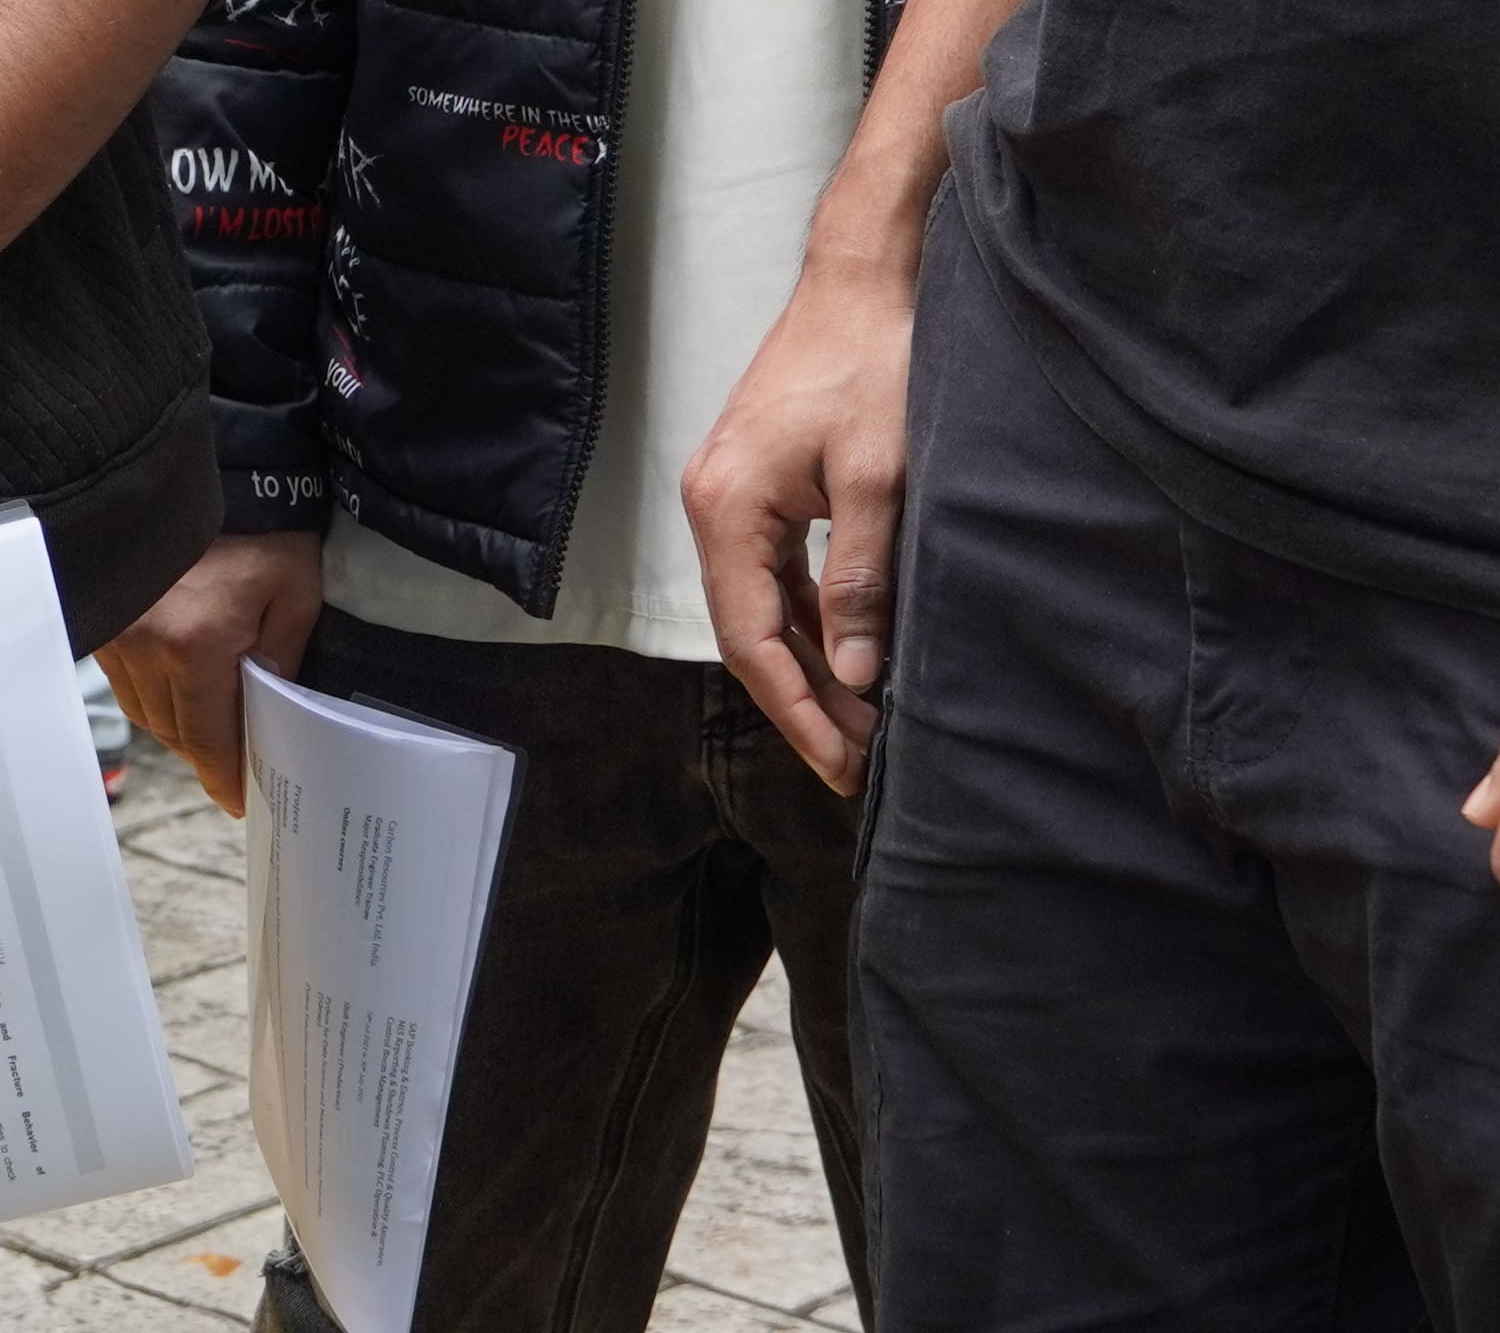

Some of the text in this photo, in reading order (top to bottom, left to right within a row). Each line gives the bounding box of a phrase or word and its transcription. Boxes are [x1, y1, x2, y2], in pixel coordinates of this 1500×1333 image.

[407, 86, 516, 123] SOMEWHERE
[522, 107, 542, 124] IN
[547, 110, 582, 133] THE
[503, 125, 588, 166] PEACE
[170, 148, 239, 196] OW
[194, 205, 242, 241] I'M
[323, 357, 364, 400] your
[251, 470, 280, 498] to
[0, 1022, 12, 1042] and
[7, 1054, 24, 1098] Fracture
[21, 1110, 39, 1153] Behavior
[35, 1166, 47, 1176] of
